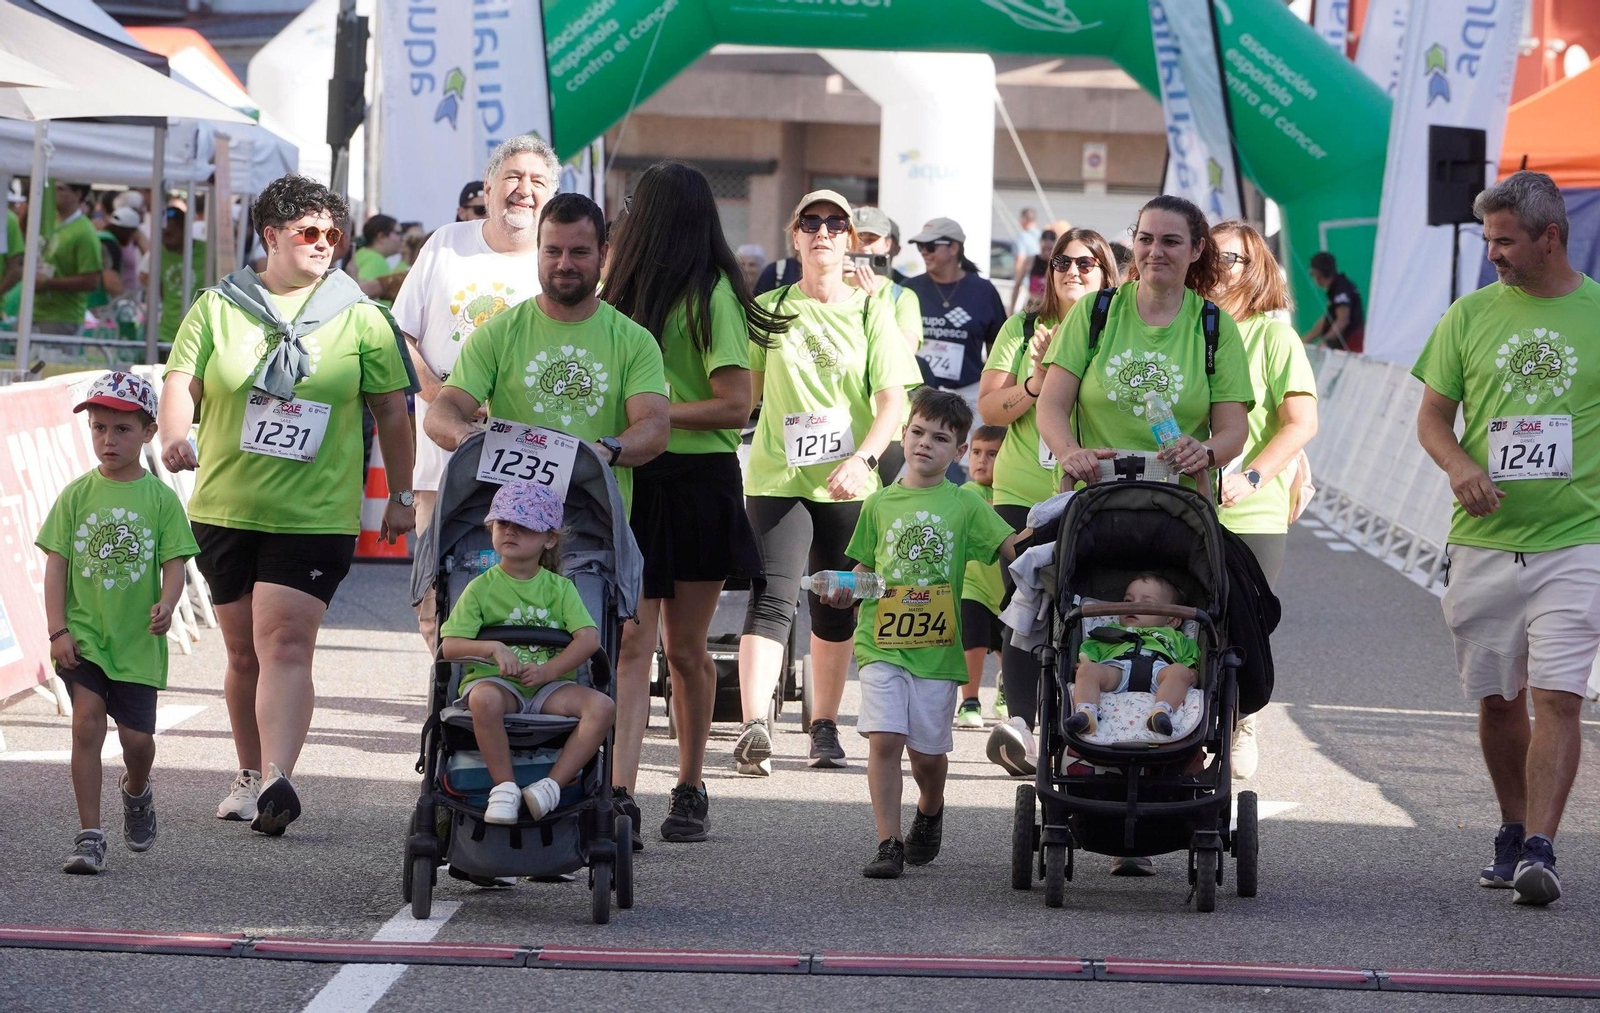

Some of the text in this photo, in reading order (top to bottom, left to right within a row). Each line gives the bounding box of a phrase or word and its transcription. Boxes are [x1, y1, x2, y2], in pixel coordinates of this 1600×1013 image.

[565, 49, 615, 91] contra
[614, 33, 631, 52] el
[254, 421, 311, 451] 1231
[796, 431, 842, 457] 1215
[490, 448, 559, 486] 1235
[1500, 443, 1557, 470] 1241
[878, 611, 947, 638] 2034
